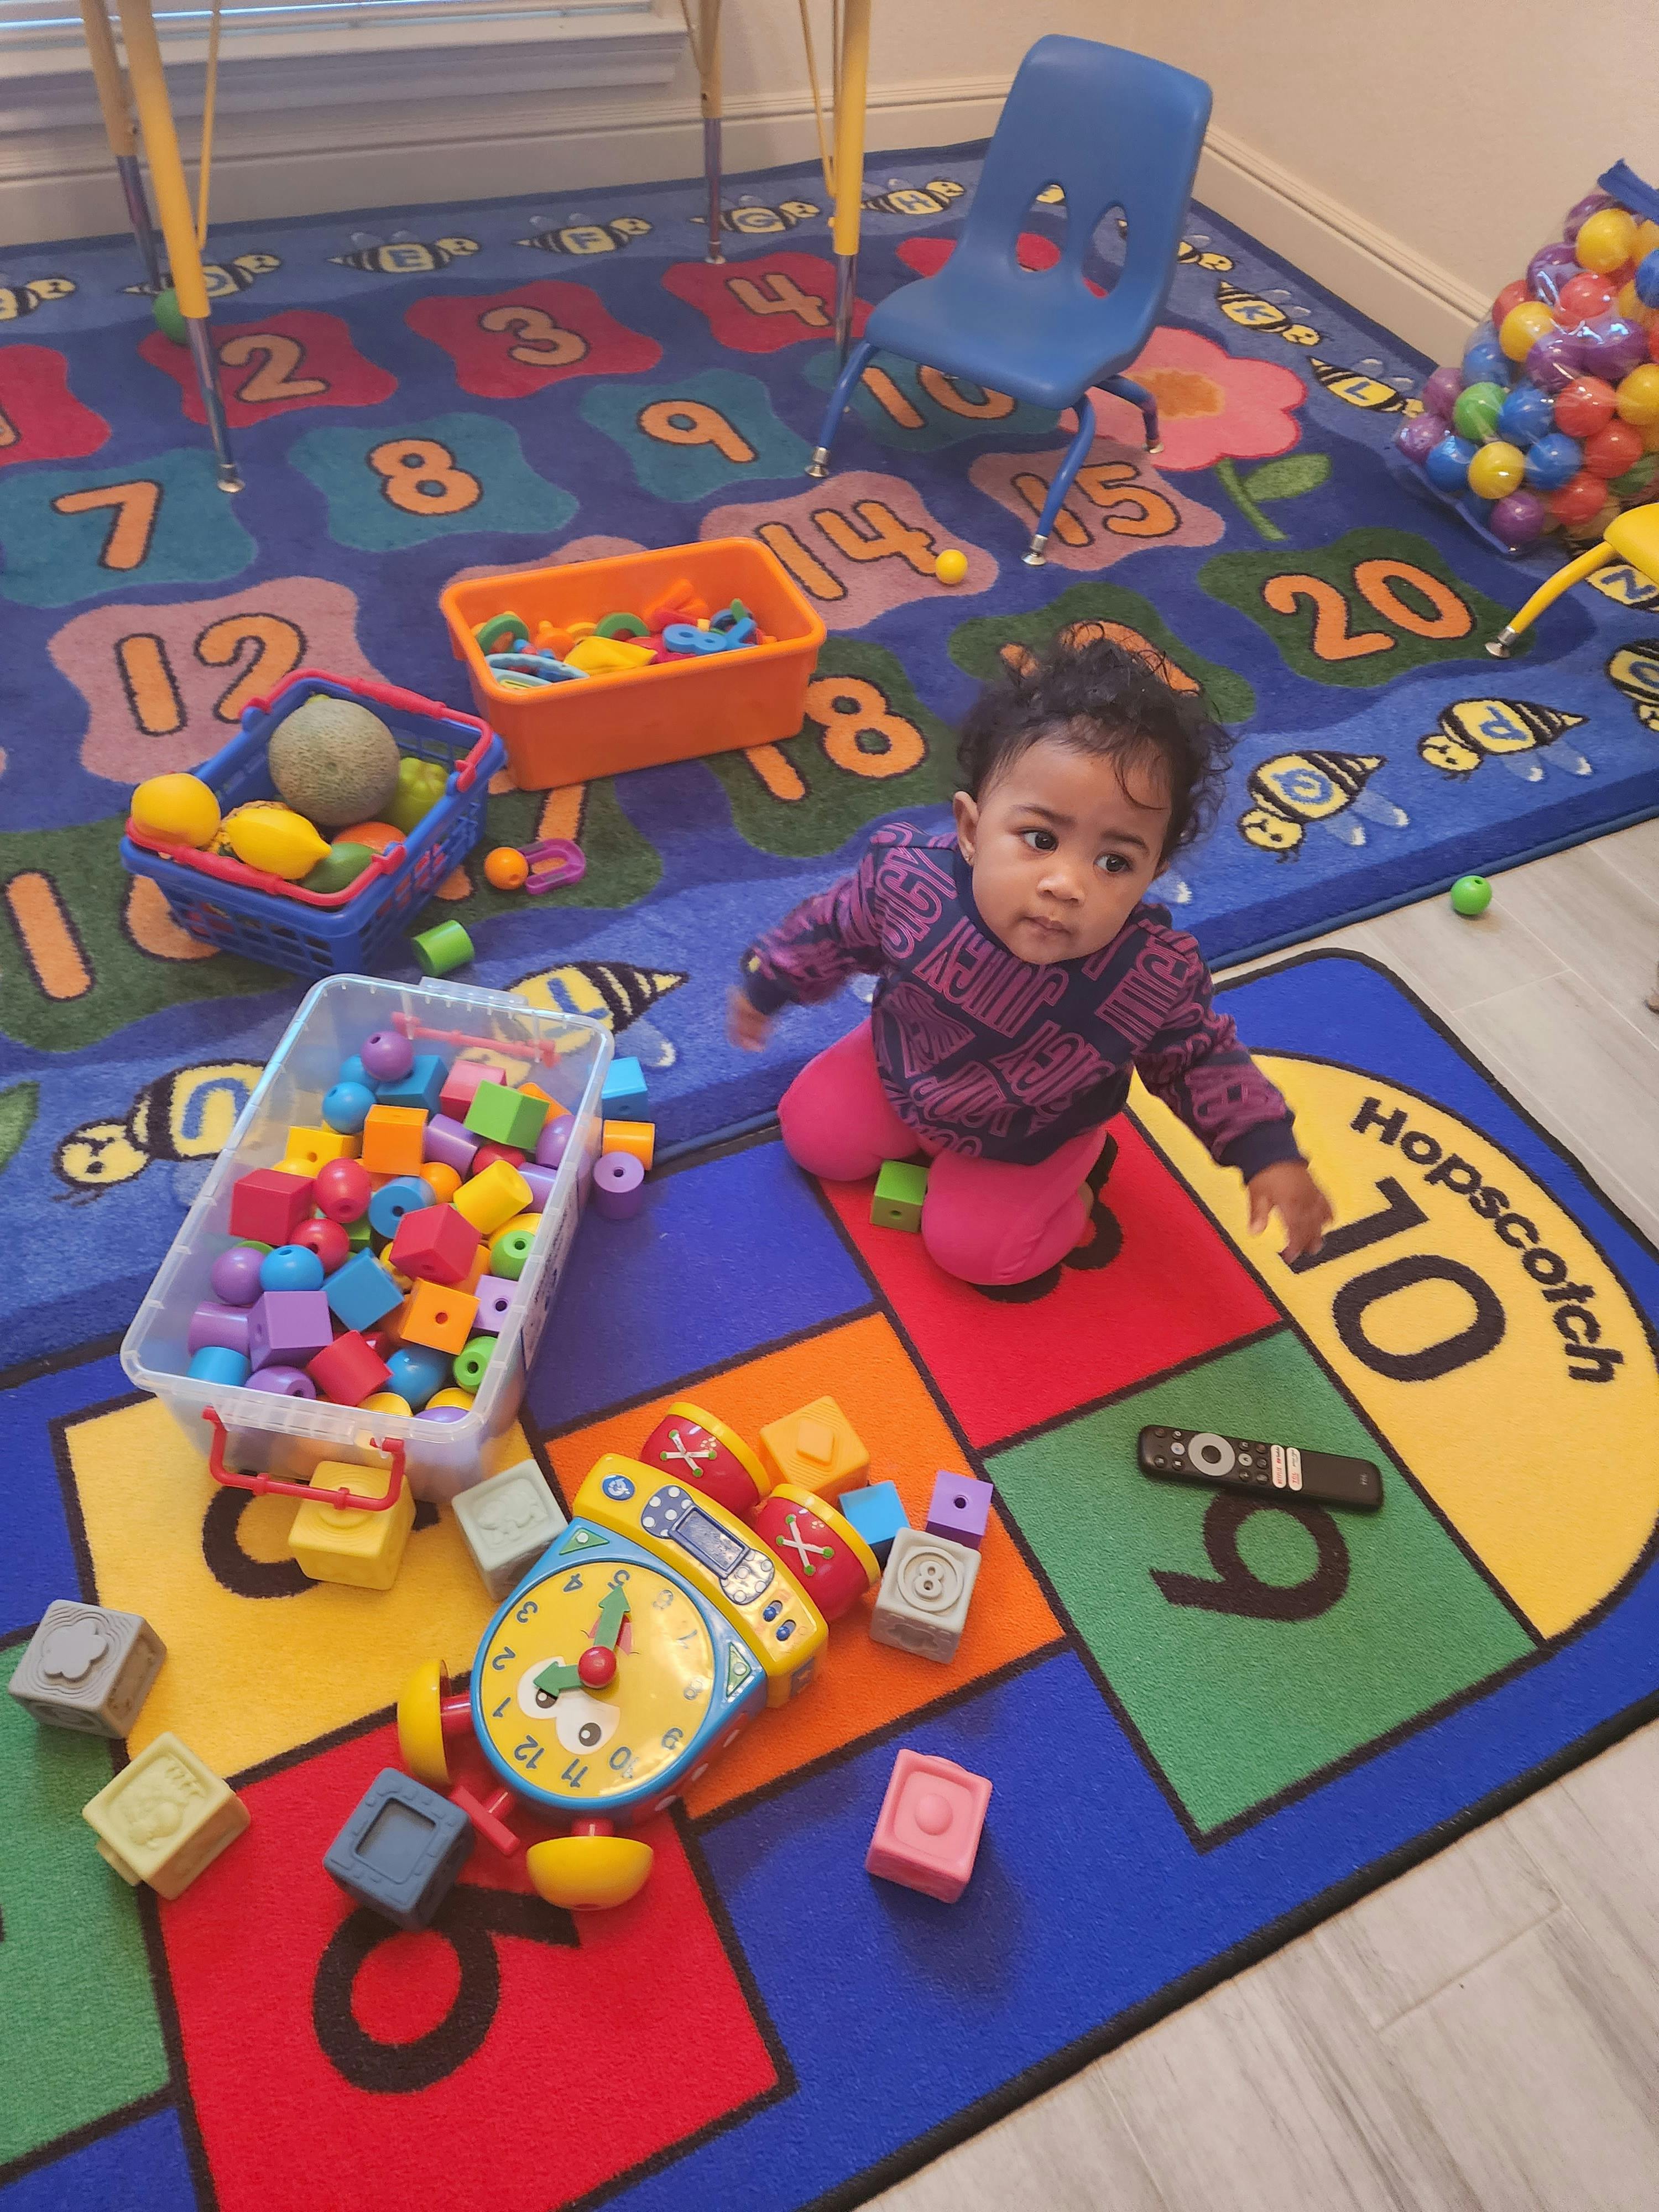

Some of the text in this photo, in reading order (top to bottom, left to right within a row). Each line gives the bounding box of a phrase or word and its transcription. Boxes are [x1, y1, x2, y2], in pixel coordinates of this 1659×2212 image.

[895, 193, 928, 211] H
[738, 212, 774, 229] G
[573, 232, 603, 249] F
[389, 249, 425, 268] E
[726, 273, 832, 327] 4
[1232, 305, 1276, 321] K
[478, 305, 591, 367] 3
[219, 333, 331, 403] 2
[1344, 381, 1370, 400] L
[637, 399, 758, 463] 9
[365, 438, 483, 516] 8
[1010, 460, 1181, 546] 15
[50, 479, 163, 571] 7
[755, 500, 937, 601] 14
[1261, 559, 1475, 661] 20
[114, 613, 308, 735] 12
[1480, 706, 1529, 741] P
[1350, 1095, 1624, 1384] Hopscotch
[1280, 1175, 1507, 1383] 10
[1149, 1491, 1350, 1623] 9
[564, 1573, 583, 1593] 4
[608, 1569, 630, 1590] 5
[914, 1559, 945, 1602] 8
[517, 1601, 538, 1623] 3
[492, 1647, 515, 1671] 2
[684, 1678, 704, 1700] 8
[493, 1697, 511, 1718] 1
[514, 1735, 545, 1770] 12
[662, 1728, 684, 1750] 9
[562, 1759, 588, 1788] 11
